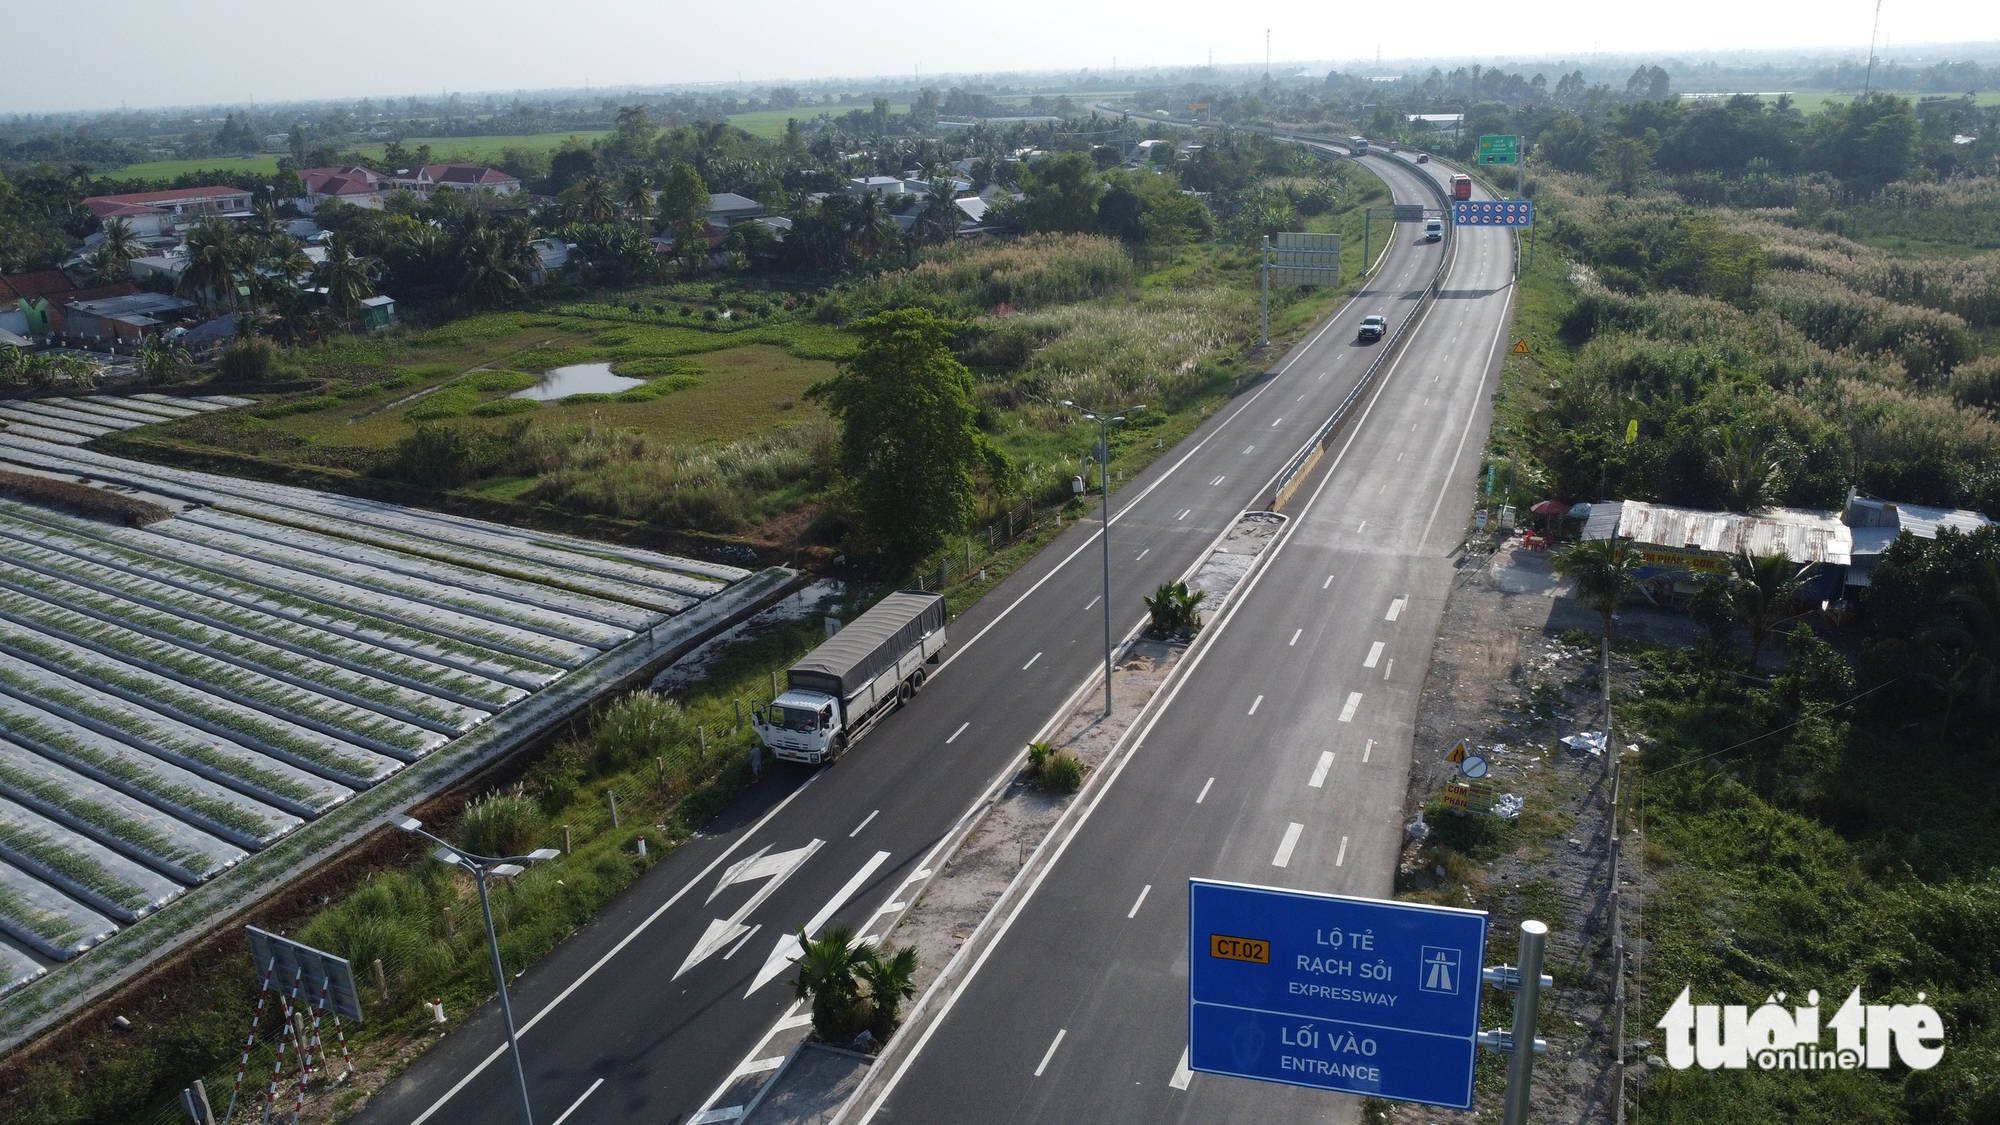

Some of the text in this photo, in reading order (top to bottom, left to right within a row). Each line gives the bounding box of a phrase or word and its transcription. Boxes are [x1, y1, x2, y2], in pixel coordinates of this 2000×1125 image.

[1448, 785, 1468, 796] CƠM
[1217, 939, 1263, 960] CT.02
[1316, 927, 1375, 952] LỘ TẺ
[1296, 954, 1393, 983] RẠCH SỎI
[1288, 982, 1398, 1007] EXPRESSWAY
[1281, 1023, 1378, 1058] LỐI VÀO
[1281, 1055, 1380, 1083] ENTRANCE
